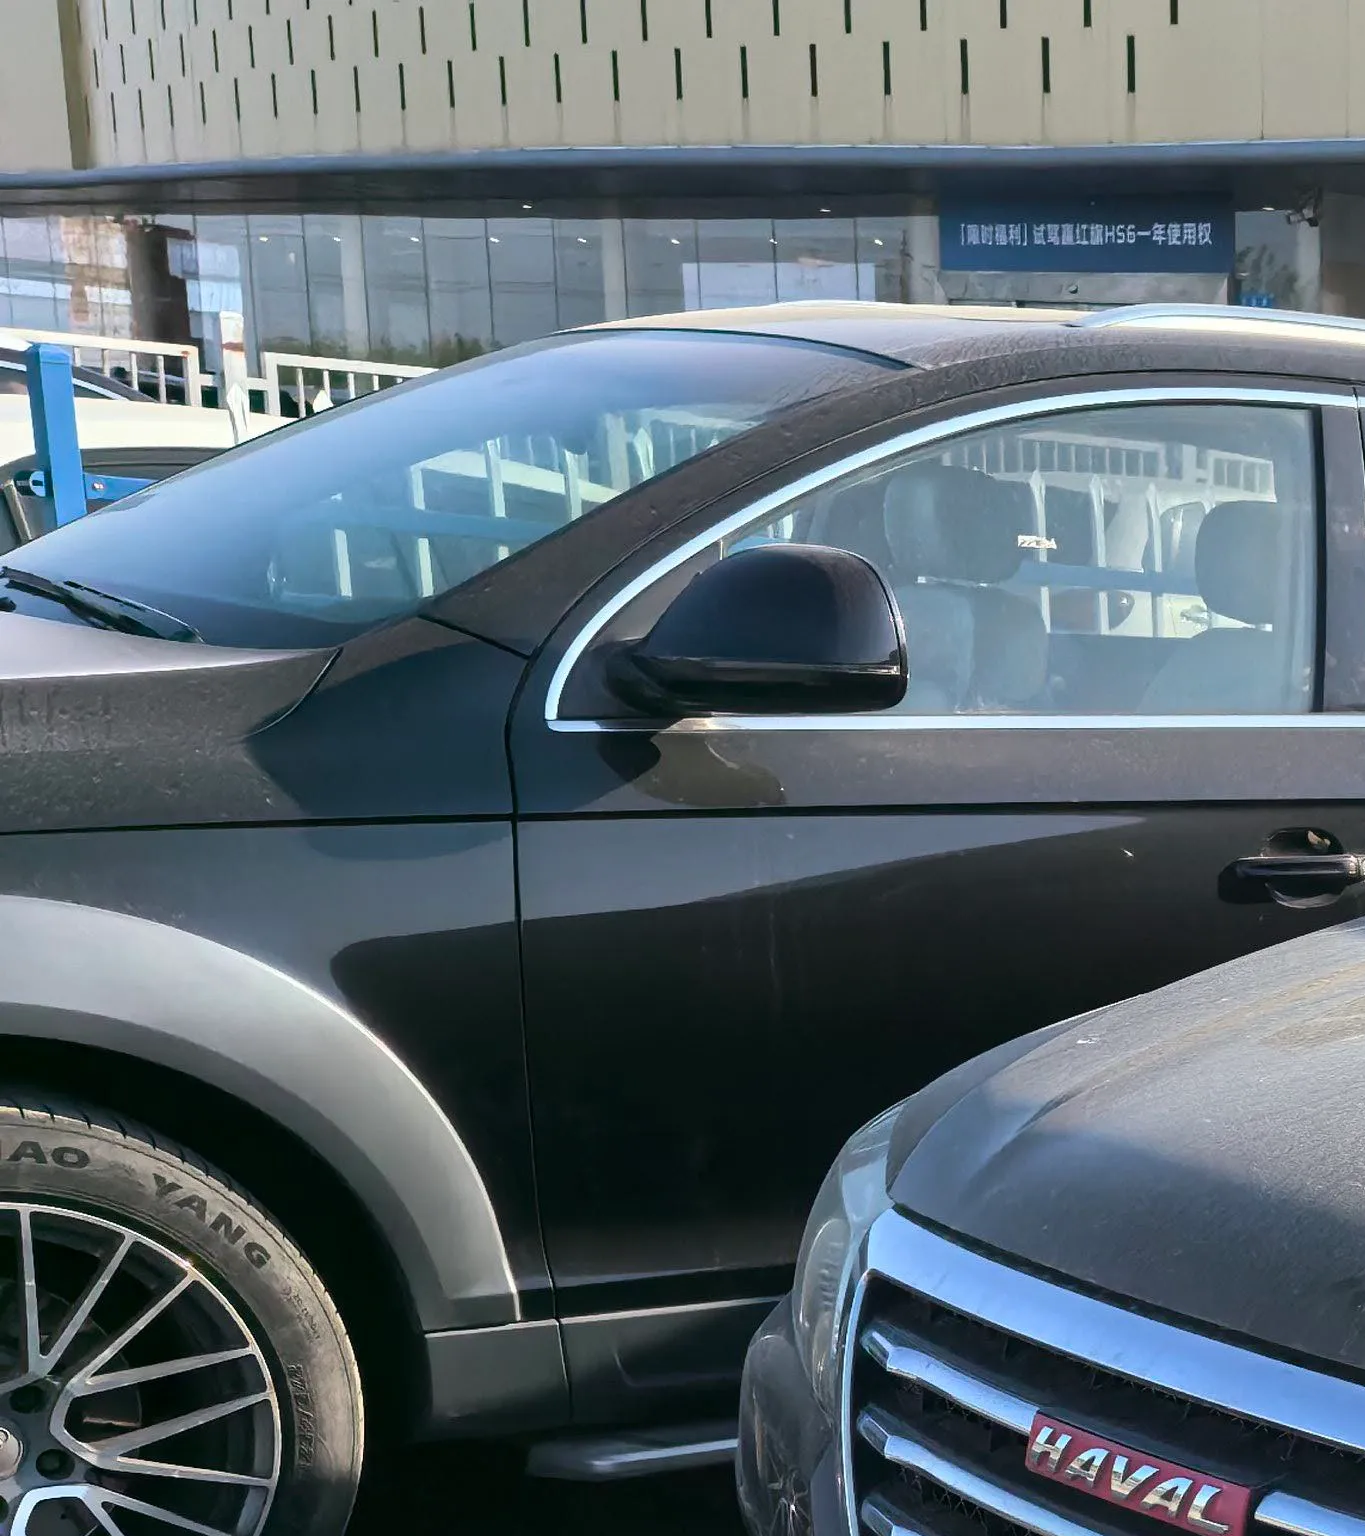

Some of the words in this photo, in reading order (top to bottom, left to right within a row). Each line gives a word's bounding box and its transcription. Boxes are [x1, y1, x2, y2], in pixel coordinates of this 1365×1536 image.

[0, 1140, 90, 1169] AO
[151, 1172, 272, 1270] YANG
[1029, 1425, 1230, 1535] HAVAL
